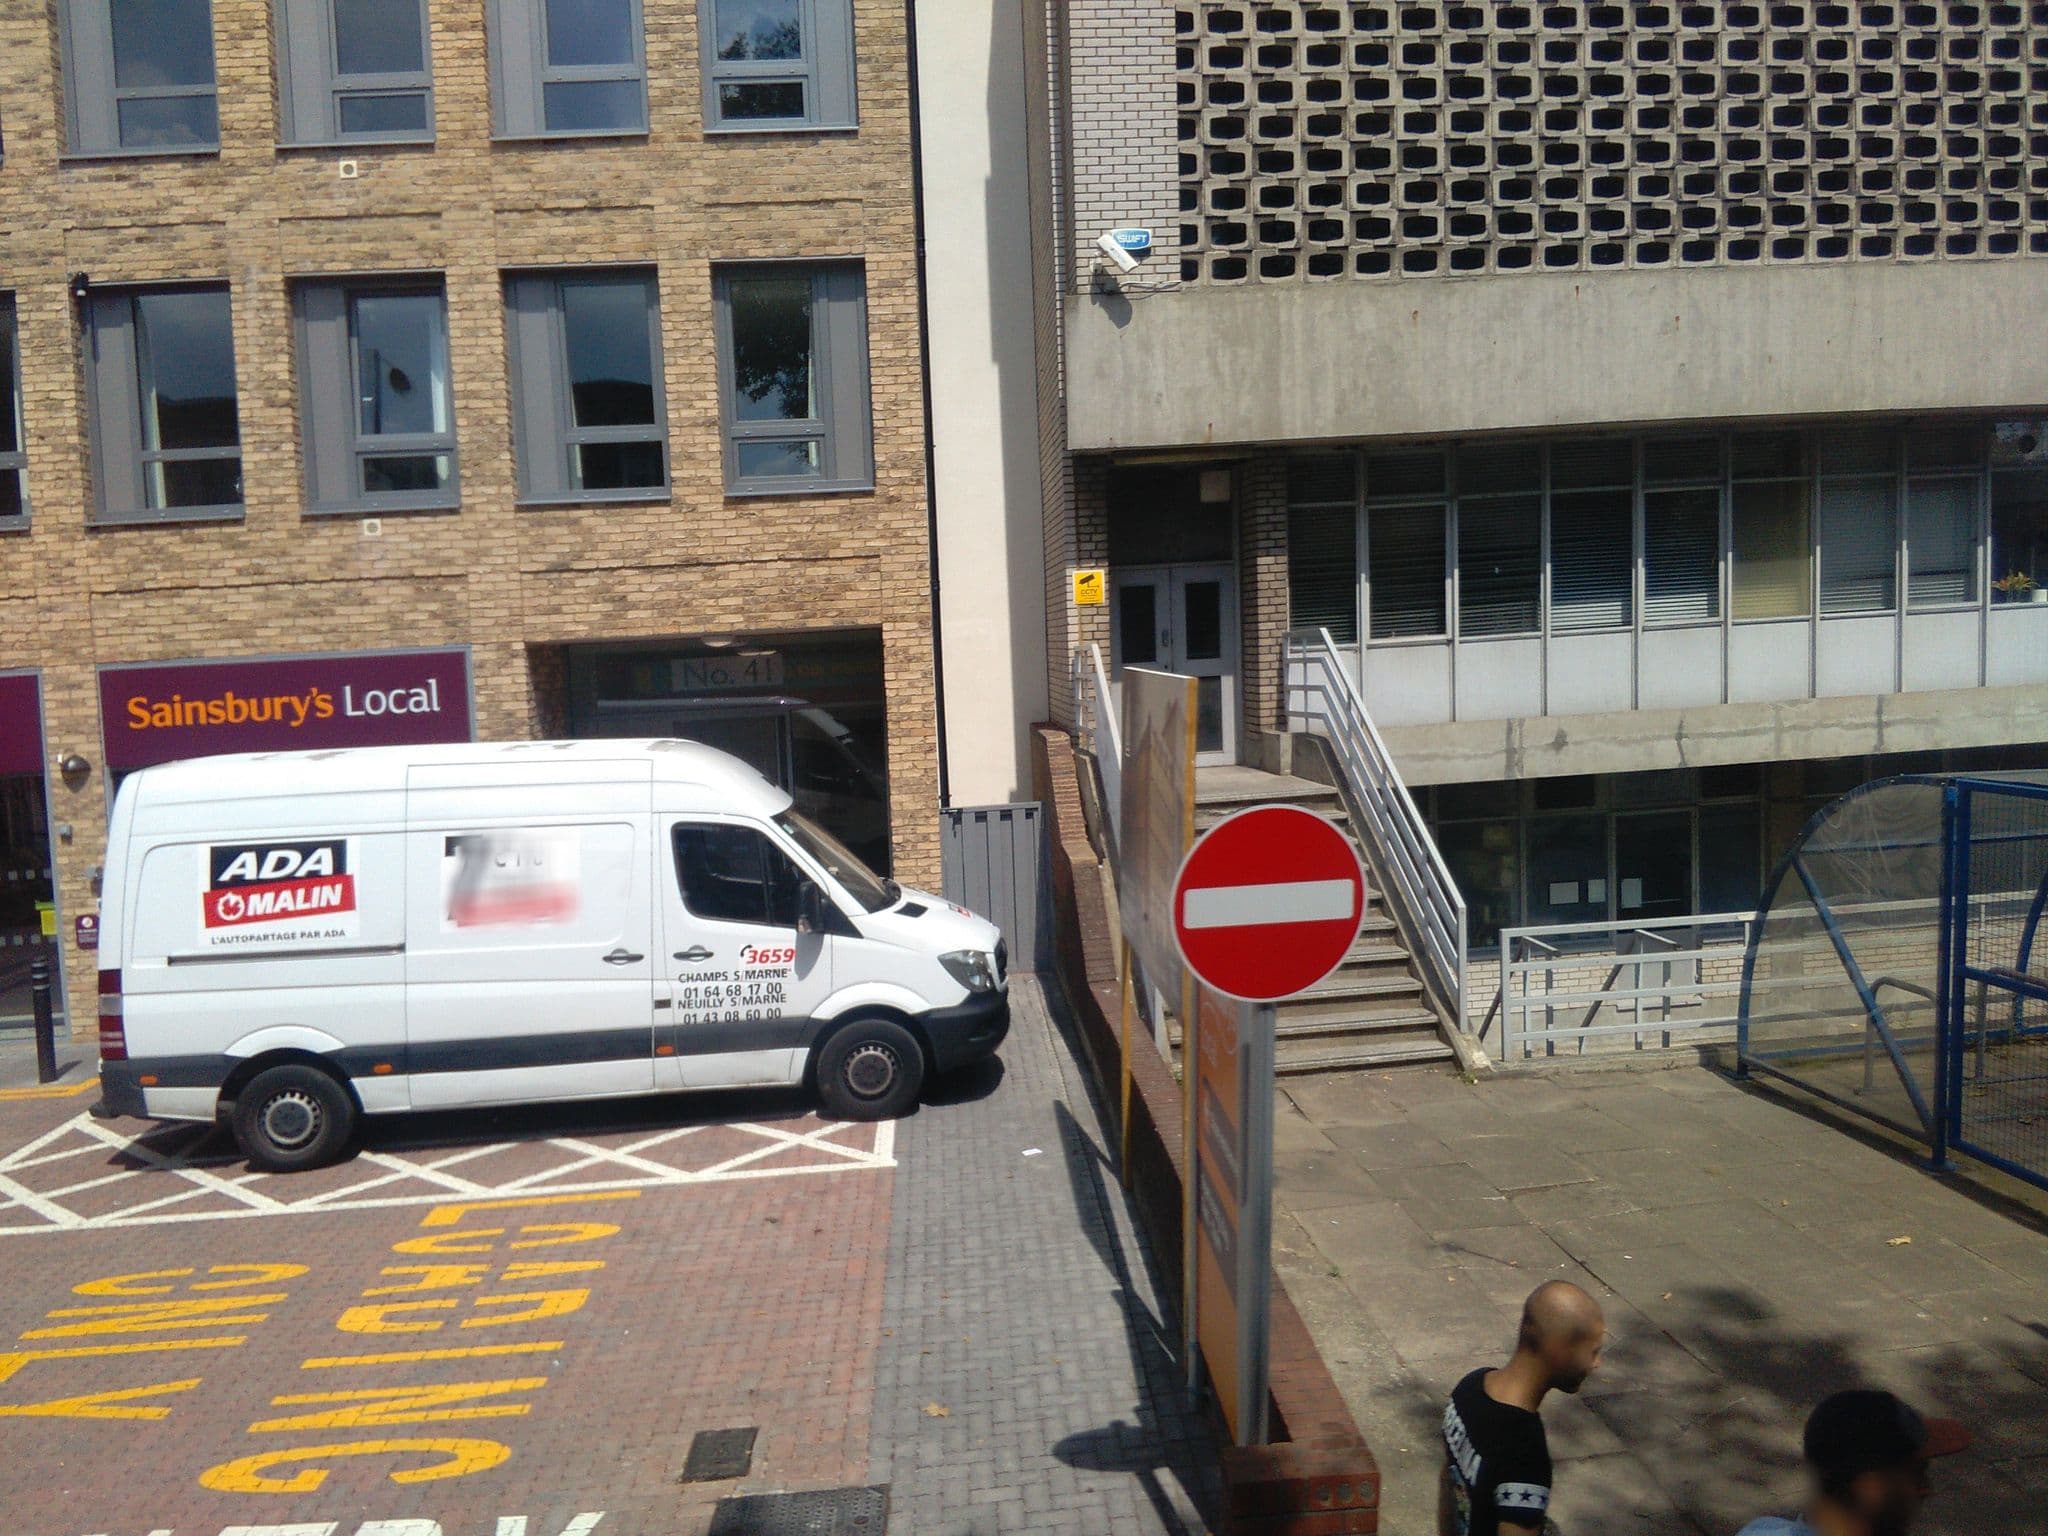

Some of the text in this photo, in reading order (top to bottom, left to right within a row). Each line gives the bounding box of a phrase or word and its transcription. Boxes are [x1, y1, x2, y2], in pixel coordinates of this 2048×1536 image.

[127, 678, 441, 729] Sainsbury's Local
[216, 847, 334, 882] ADA
[246, 883, 343, 917] MALIN
[211, 929, 346, 945] L'AUTOPARTAGE PAR ADA
[746, 948, 796, 964] 3659
[678, 970, 729, 983] CHAMPS
[684, 982, 782, 999] 01 64 68 17 00
[678, 996, 725, 1010] NEUILLY
[683, 1007, 782, 1025] 01 43 08 60 00
[0, 1262, 309, 1420] ONLY
[199, 1190, 641, 1493] LOADING
